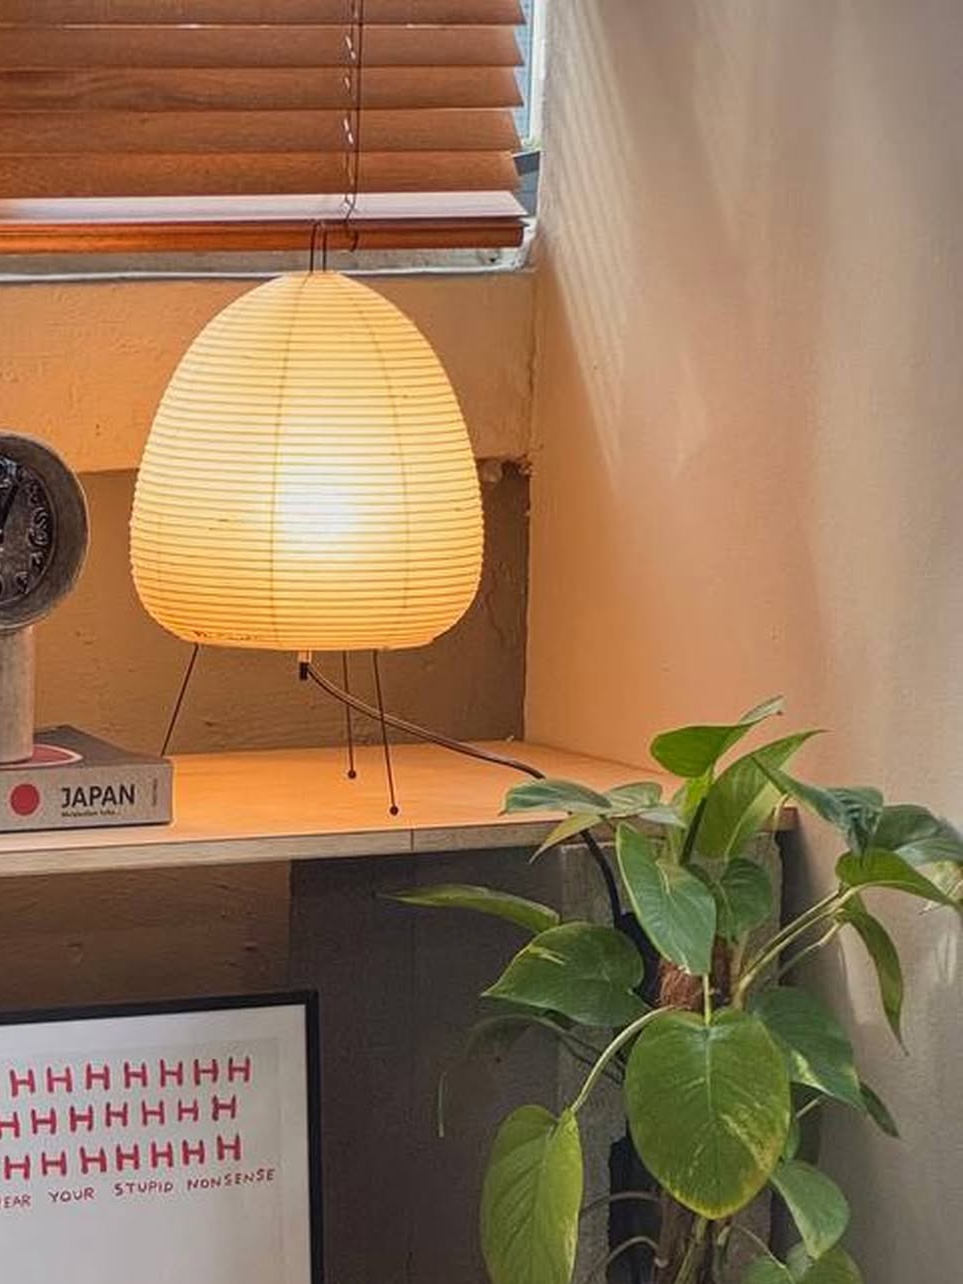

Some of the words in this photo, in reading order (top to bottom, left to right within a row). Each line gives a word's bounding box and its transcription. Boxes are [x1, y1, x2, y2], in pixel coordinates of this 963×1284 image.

[61, 784, 135, 808] JAPAN
[48, 1188, 95, 1202] YOUR
[114, 1181, 173, 1196] STUPID
[187, 1169, 275, 1190] NONSENSE
